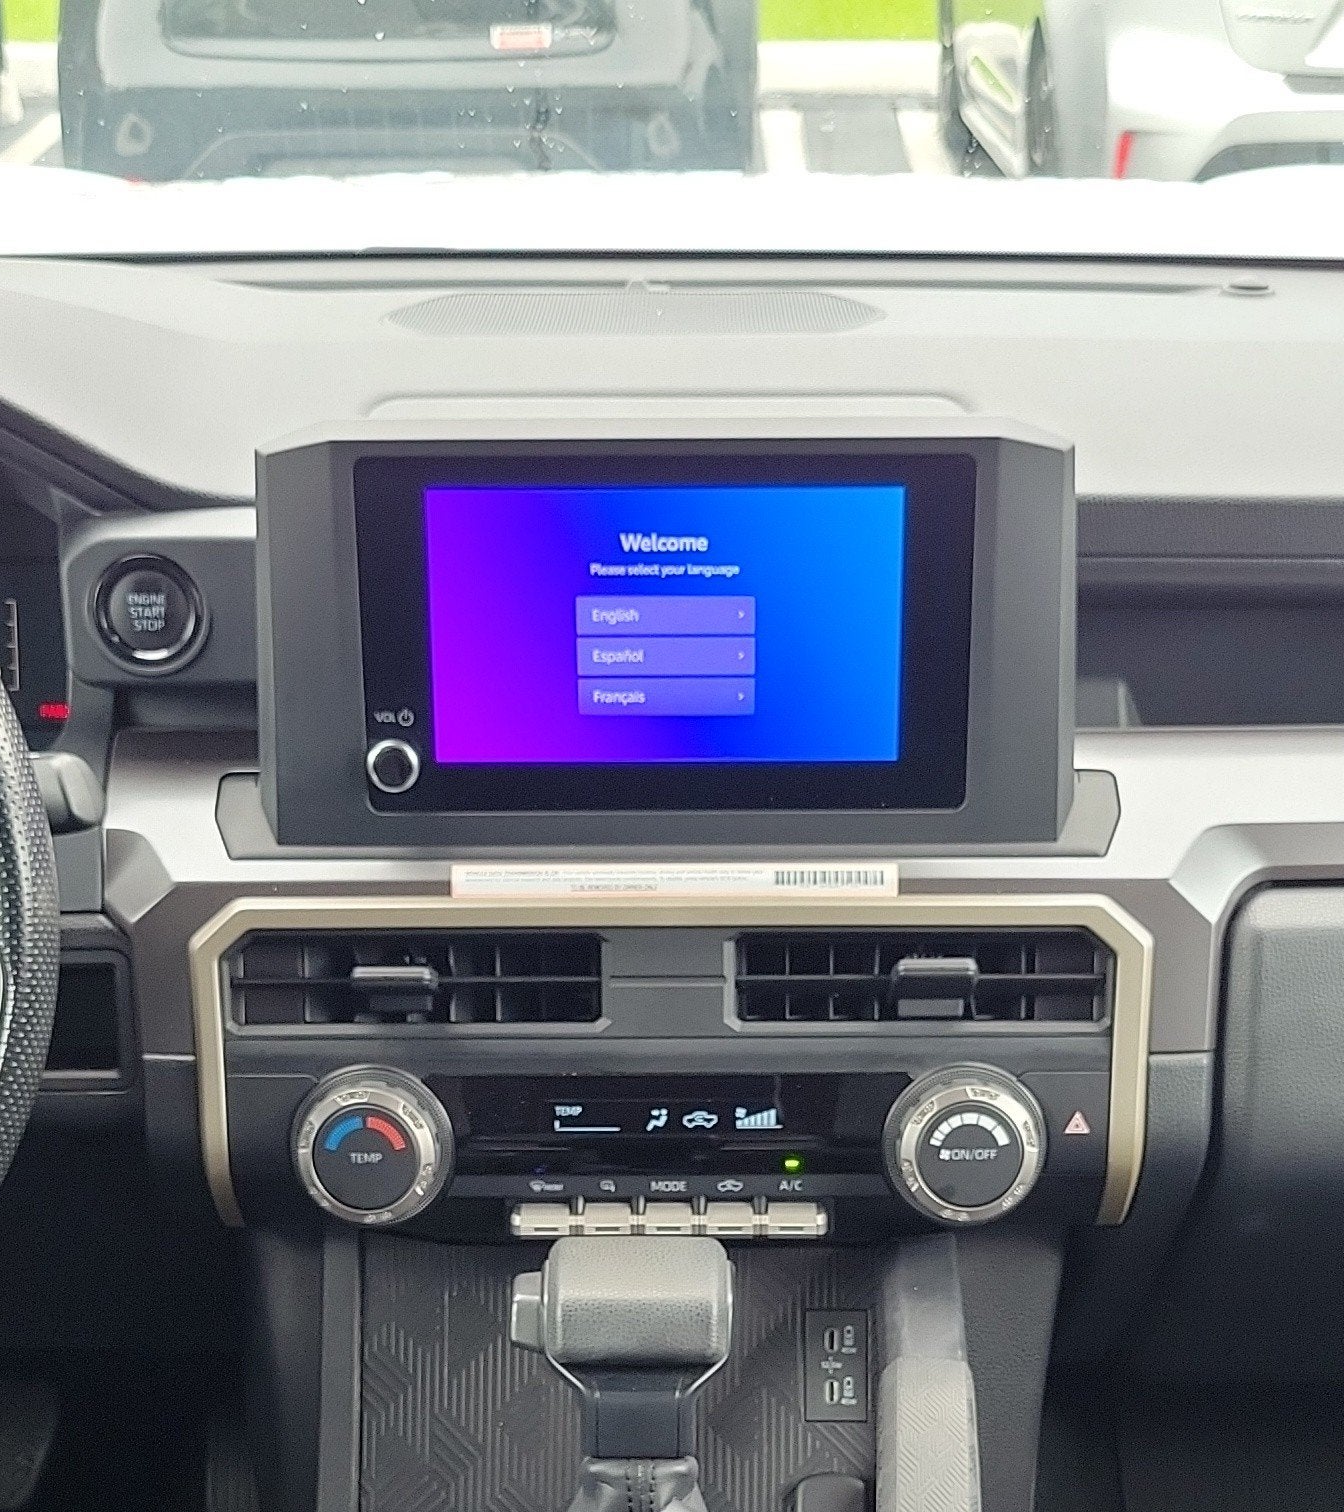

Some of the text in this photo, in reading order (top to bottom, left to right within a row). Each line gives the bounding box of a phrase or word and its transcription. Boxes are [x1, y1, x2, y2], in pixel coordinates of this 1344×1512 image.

[619, 532, 709, 552] Welcome
[589, 563, 740, 578] Please select your language
[129, 606, 165, 619] START
[591, 608, 640, 625] English
[133, 619, 165, 631] STOP
[591, 649, 645, 665] Español
[592, 690, 646, 706] Français
[350, 1152, 384, 1165] TEMP
[952, 1148, 998, 1161] ON/OFF
[650, 1180, 688, 1192] MODE
[779, 1179, 803, 1191] A/C
